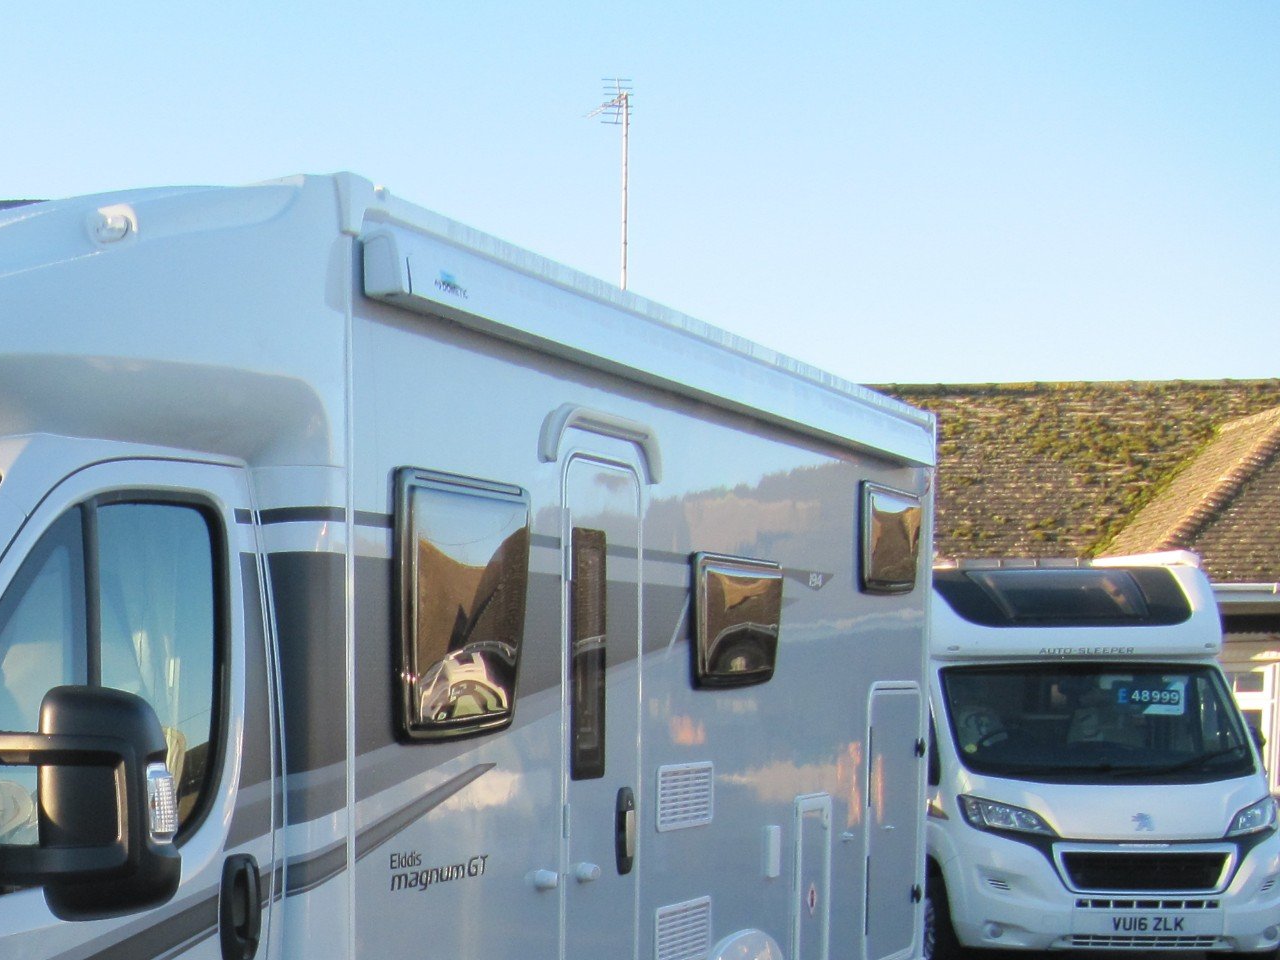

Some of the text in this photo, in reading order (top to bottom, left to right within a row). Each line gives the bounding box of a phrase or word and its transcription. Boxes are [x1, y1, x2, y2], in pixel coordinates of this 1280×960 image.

[808, 571, 824, 588] 194
[389, 851, 422, 870] Elddis
[389, 854, 489, 892] magnum GT
[1112, 916, 1185, 932] VU16 ZLK
